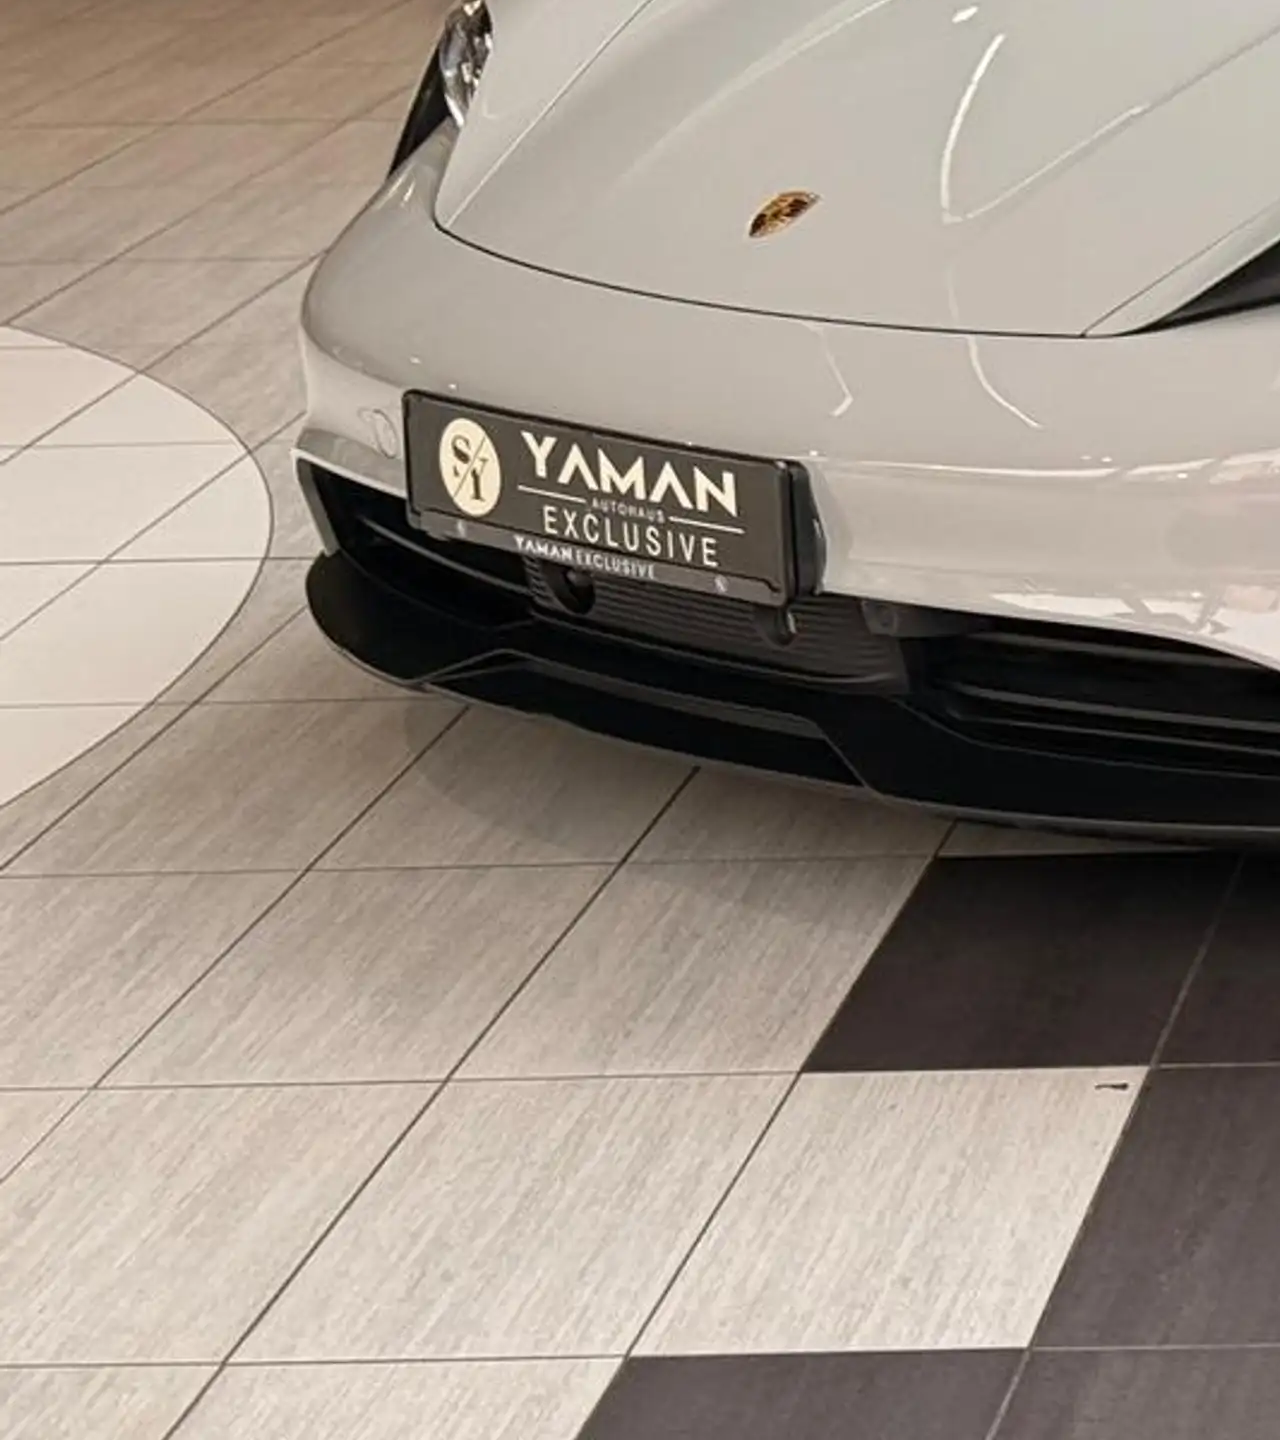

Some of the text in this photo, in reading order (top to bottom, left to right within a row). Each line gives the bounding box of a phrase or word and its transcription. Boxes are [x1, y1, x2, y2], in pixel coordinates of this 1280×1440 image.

[519, 430, 739, 517] YAMAN
[542, 504, 720, 568] EXCLUSIVE
[591, 498, 666, 523] AUTOHAUS
[513, 535, 657, 580] YAMAN EXCLUSIVE
